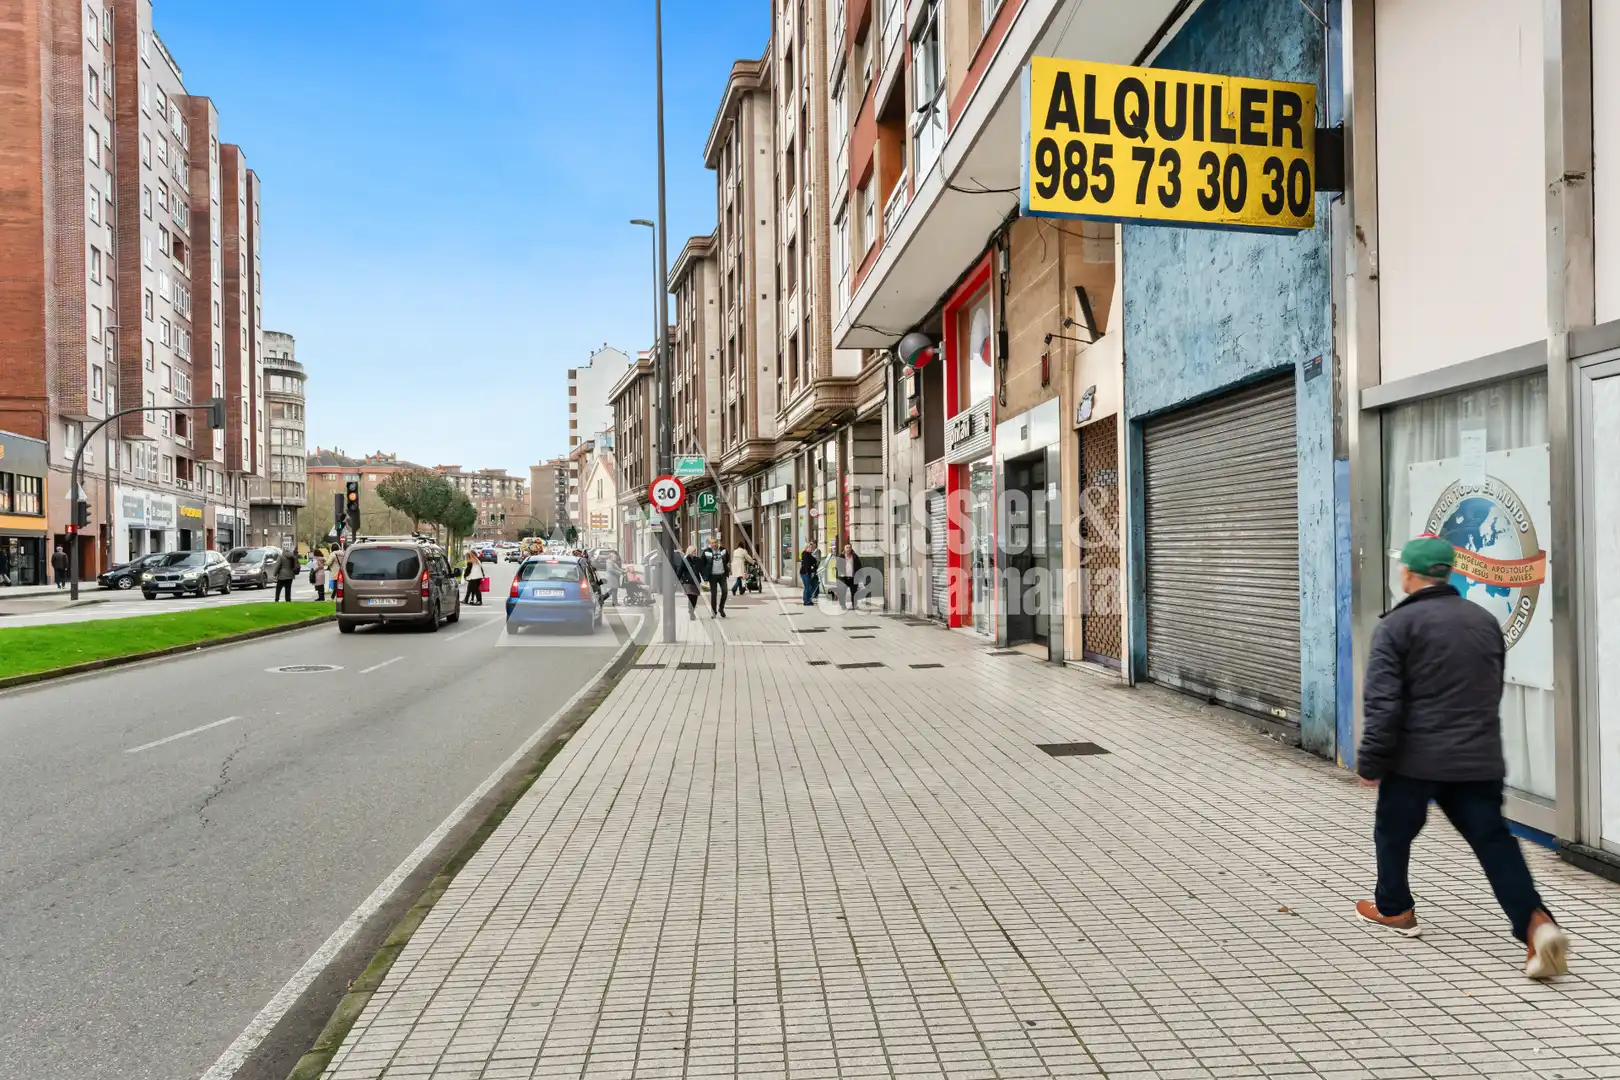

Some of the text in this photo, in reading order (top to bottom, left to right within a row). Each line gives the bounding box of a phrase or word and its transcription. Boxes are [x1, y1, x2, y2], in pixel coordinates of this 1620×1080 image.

[1044, 71, 1303, 149] ALQUILER
[1035, 136, 1311, 218] 985 73 30 30
[657, 487, 677, 500] 30
[703, 494, 715, 507] JB
[1435, 495, 1453, 520] POR
[1481, 479, 1497, 497] EL
[1495, 487, 1529, 535] MUNDO
[1461, 562, 1469, 571] DE
[1494, 573, 1503, 582] EN
[1503, 596, 1532, 648] NGELIO
